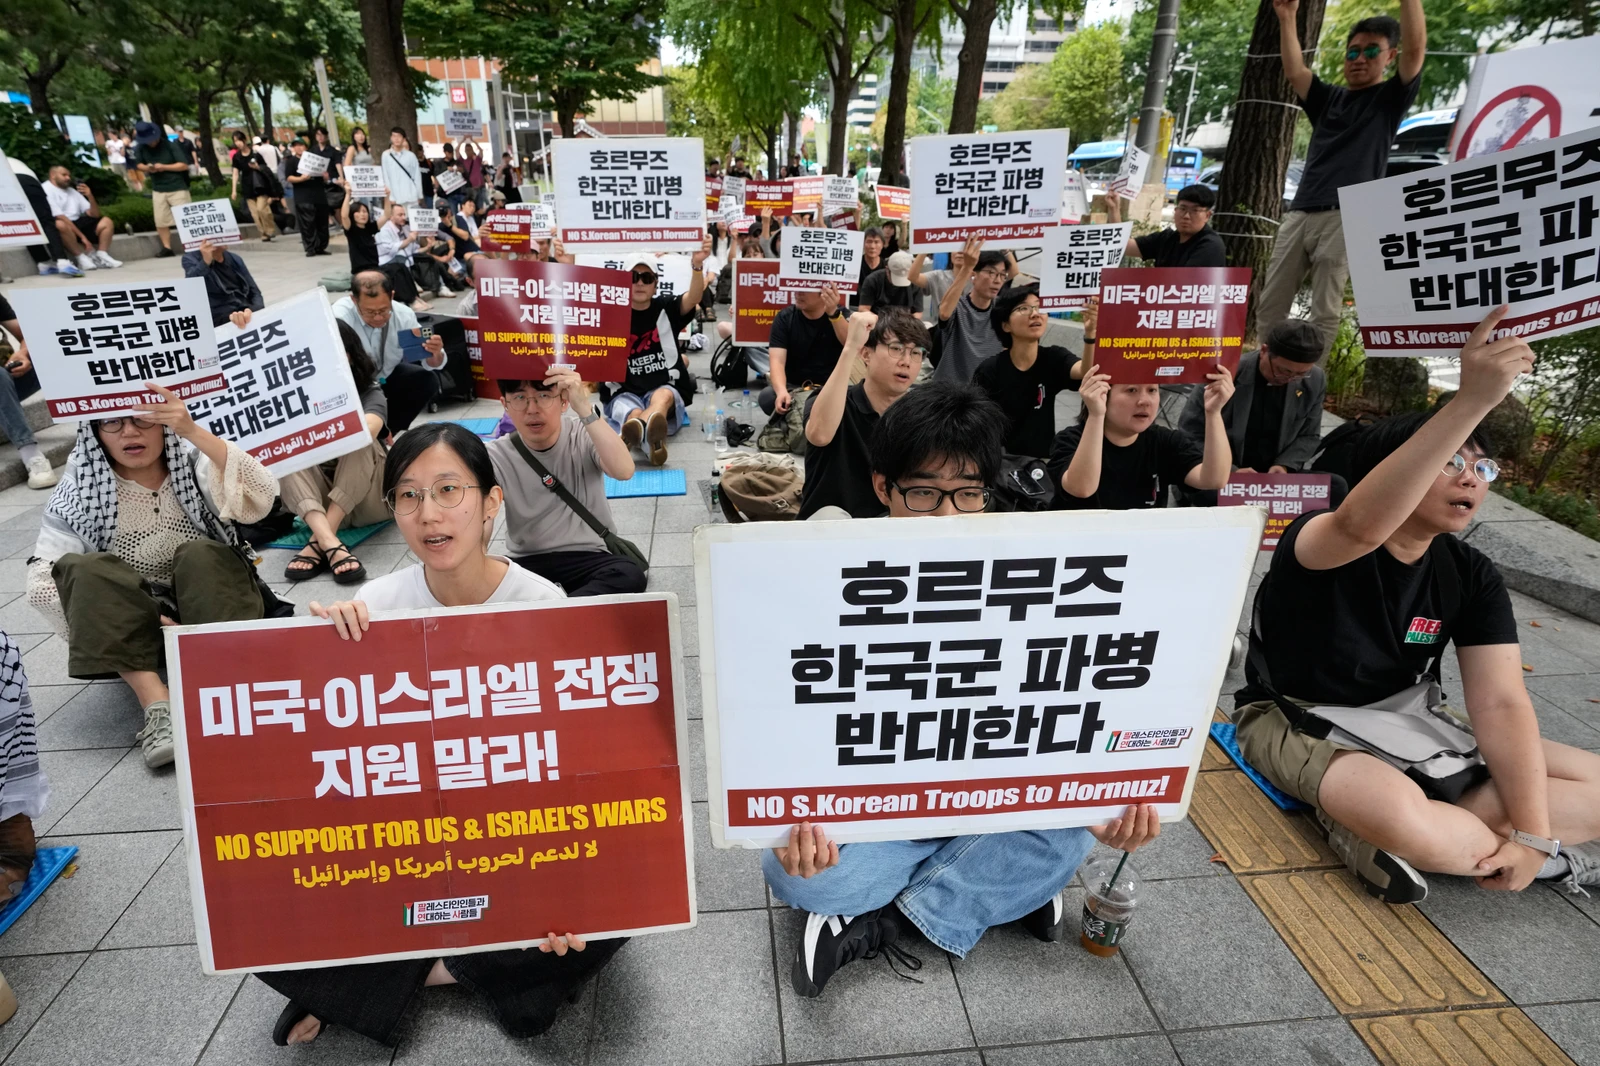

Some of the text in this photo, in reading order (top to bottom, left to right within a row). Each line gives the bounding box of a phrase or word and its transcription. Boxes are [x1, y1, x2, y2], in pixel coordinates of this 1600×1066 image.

[589, 150, 669, 170] 호르무즈
[949, 141, 1032, 166] 호르무즈
[578, 175, 637, 196] 한국군
[643, 175, 683, 196] 파병
[935, 167, 1044, 194] 한국군 파병
[1402, 138, 1600, 222] 호르무즈
[591, 199, 672, 220] 반대한다
[947, 194, 1029, 218] 반대한다
[567, 231, 580, 241] NO
[581, 230, 620, 241] S.Korean
[621, 230, 652, 241] Troops
[653, 230, 661, 239] to
[800, 230, 847, 245] 호르무즈
[1069, 227, 1123, 247] 호르무즈
[1379, 195, 1600, 271] 한국군 파
[792, 245, 853, 262] 한국군 파병
[1056, 250, 1104, 269] 한국군
[799, 261, 845, 276] 반대한다
[739, 273, 780, 288] 미국·이
[1065, 271, 1101, 289] 반대
[480, 277, 630, 306] 미국·이스라엘 전쟁
[763, 290, 788, 304] 지원
[1103, 284, 1216, 304] 미국·이스라엘
[1219, 284, 1248, 304] 전쟁
[67, 286, 181, 321] 호르무즈
[519, 304, 601, 328] 지원 말라!
[1136, 309, 1218, 329] 지원 말라!
[55, 315, 200, 356] 한국군 파병
[1369, 309, 1578, 345] NO S.Korean roops to
[217, 319, 290, 371] 르무즈
[484, 331, 496, 342] NO
[497, 332, 538, 344] SUPPORT
[539, 333, 556, 345] FOR
[557, 333, 569, 345] US
[570, 335, 576, 344] &
[577, 335, 606, 347] ISRAEL'S
[607, 337, 627, 348] WARS
[1099, 336, 1242, 348] NO SUPPORT FOR US & ISRAEL'S WARS
[87, 347, 195, 386] 반대한다
[261, 347, 317, 391] 파병
[632, 353, 656, 367] KEEP
[55, 376, 224, 414] NO S.Korean Tros to Hormuz!
[209, 386, 311, 442] 반대한다
[1220, 483, 1328, 498] 미국·이스라엘 전쟁
[1272, 501, 1303, 514] 말라!
[839, 554, 1128, 626] 호르무즈
[1409, 618, 1442, 634] FREE
[1405, 631, 1440, 643] PALEST
[791, 630, 1160, 704] 한국군 파병
[199, 652, 660, 736] 미국·이스라엘 전쟁
[835, 701, 1105, 766] 반대한다
[1120, 738, 1177, 749] 연대하는 사람들
[1123, 728, 1188, 740] 팔레스타인인들과
[312, 730, 560, 799] 지원 말라!
[747, 775, 1171, 819] NO S.Korean Troops to Hormuz!
[215, 797, 668, 861] NO SUPPORT FOR US & ISRAEL'S WARS
[293, 840, 599, 889] لا لدعم لحروب أمريكا وإسرائيل!
[417, 897, 486, 913] 팔레스타인인들과
[417, 908, 478, 922] 연대하는 사람들
